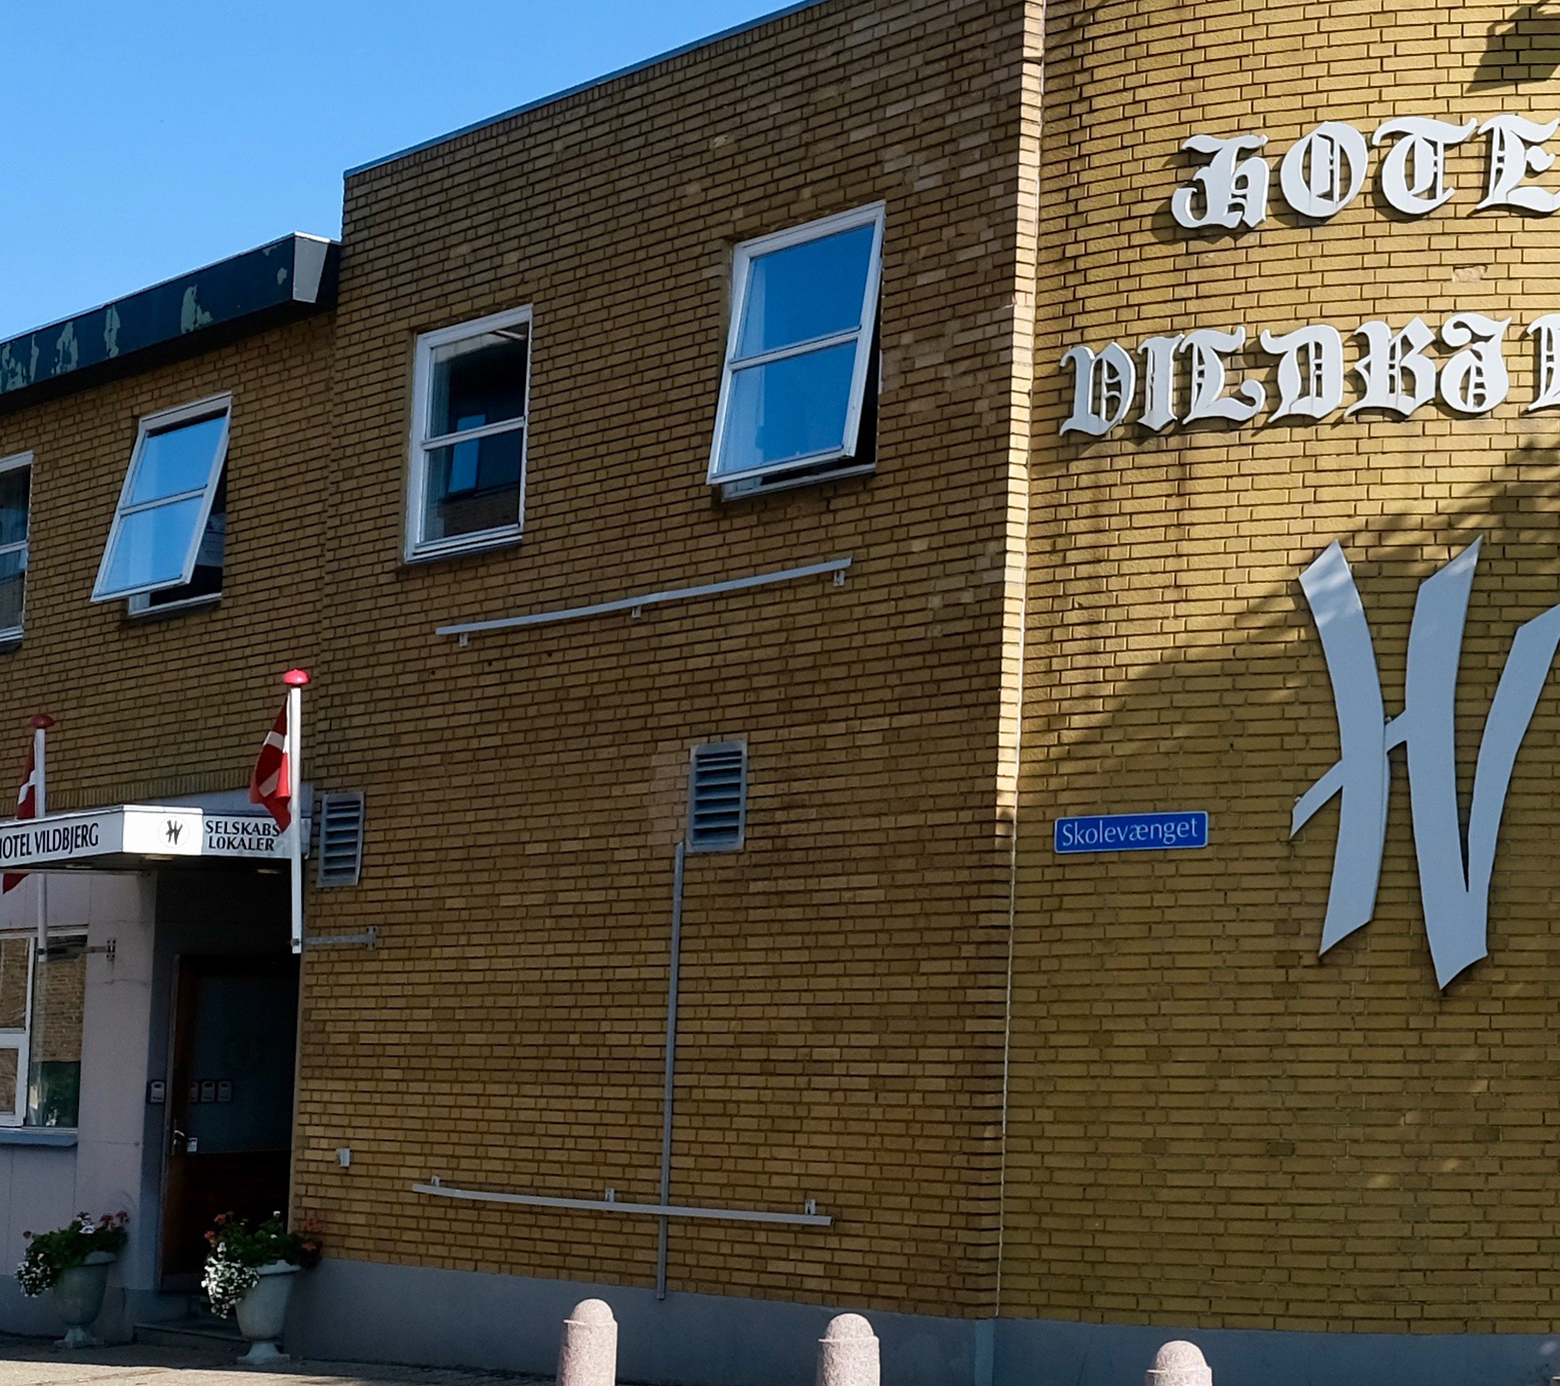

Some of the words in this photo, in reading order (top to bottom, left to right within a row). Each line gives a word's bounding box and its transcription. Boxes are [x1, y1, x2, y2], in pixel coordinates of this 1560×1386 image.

[34, 822, 99, 854] VILDBJERG
[205, 820, 280, 837] SELSKABS
[1062, 817, 1198, 846] Skolevænget
[208, 836, 275, 851] LOKALER
